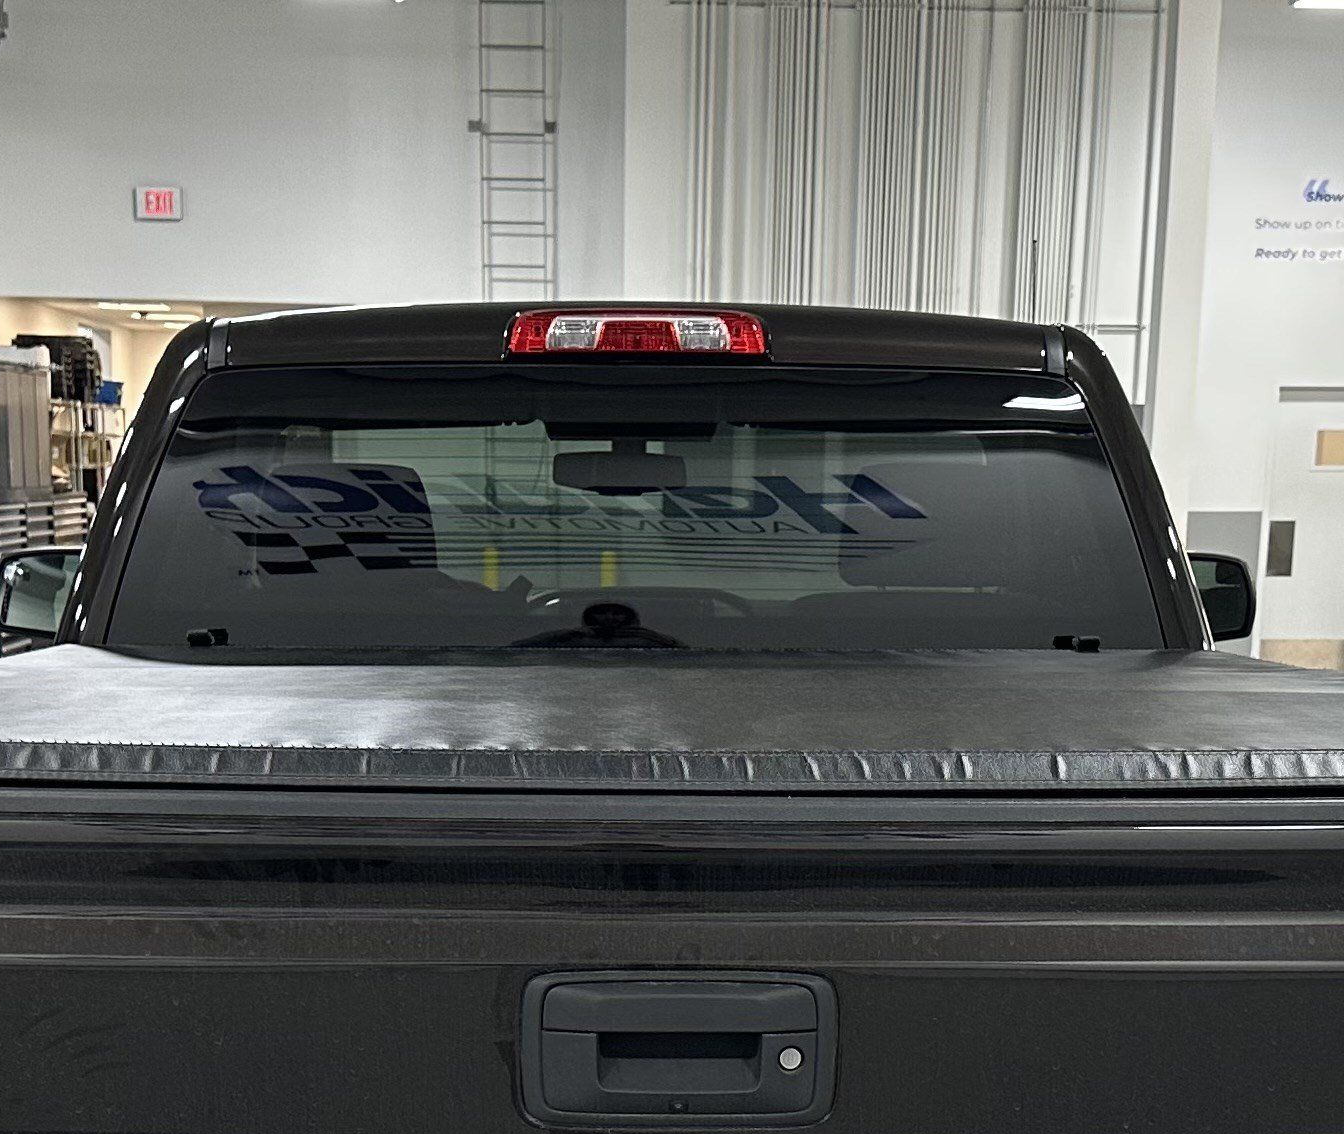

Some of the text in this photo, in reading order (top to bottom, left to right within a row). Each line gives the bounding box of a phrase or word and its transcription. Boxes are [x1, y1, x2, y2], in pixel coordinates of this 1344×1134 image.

[145, 190, 174, 215] EXIT
[1255, 218, 1291, 230] Show
[1294, 220, 1312, 233] up
[1314, 219, 1333, 231] on
[1255, 248, 1298, 261] Ready
[1301, 249, 1316, 259] to
[1318, 249, 1343, 262] get
